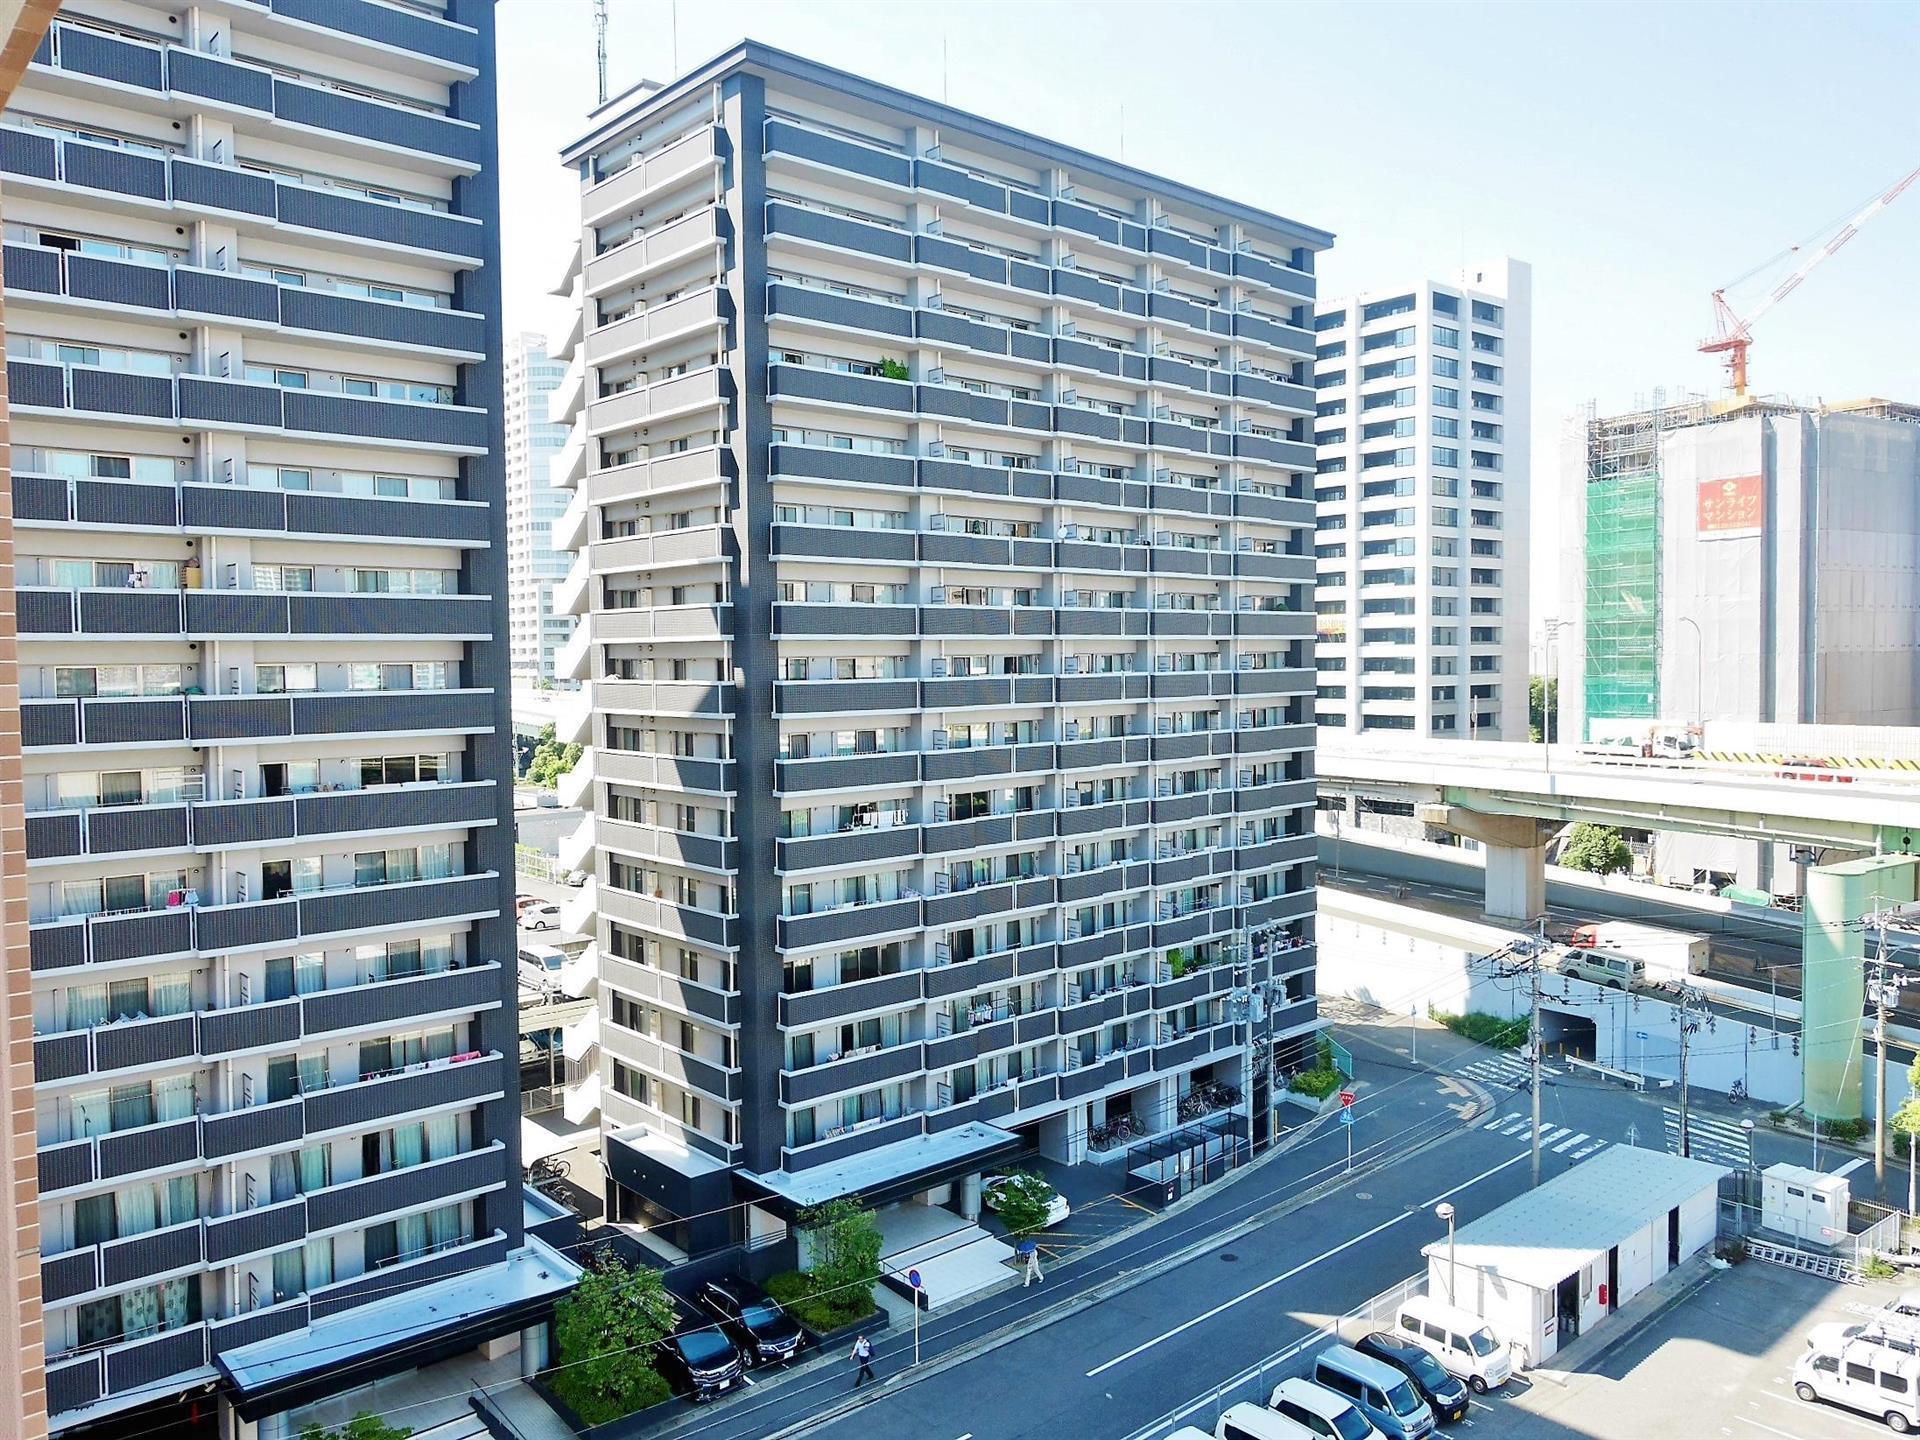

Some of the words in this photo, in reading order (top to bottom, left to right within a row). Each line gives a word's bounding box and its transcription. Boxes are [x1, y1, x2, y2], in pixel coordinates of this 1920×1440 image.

[1703, 507, 1757, 521] マンション
